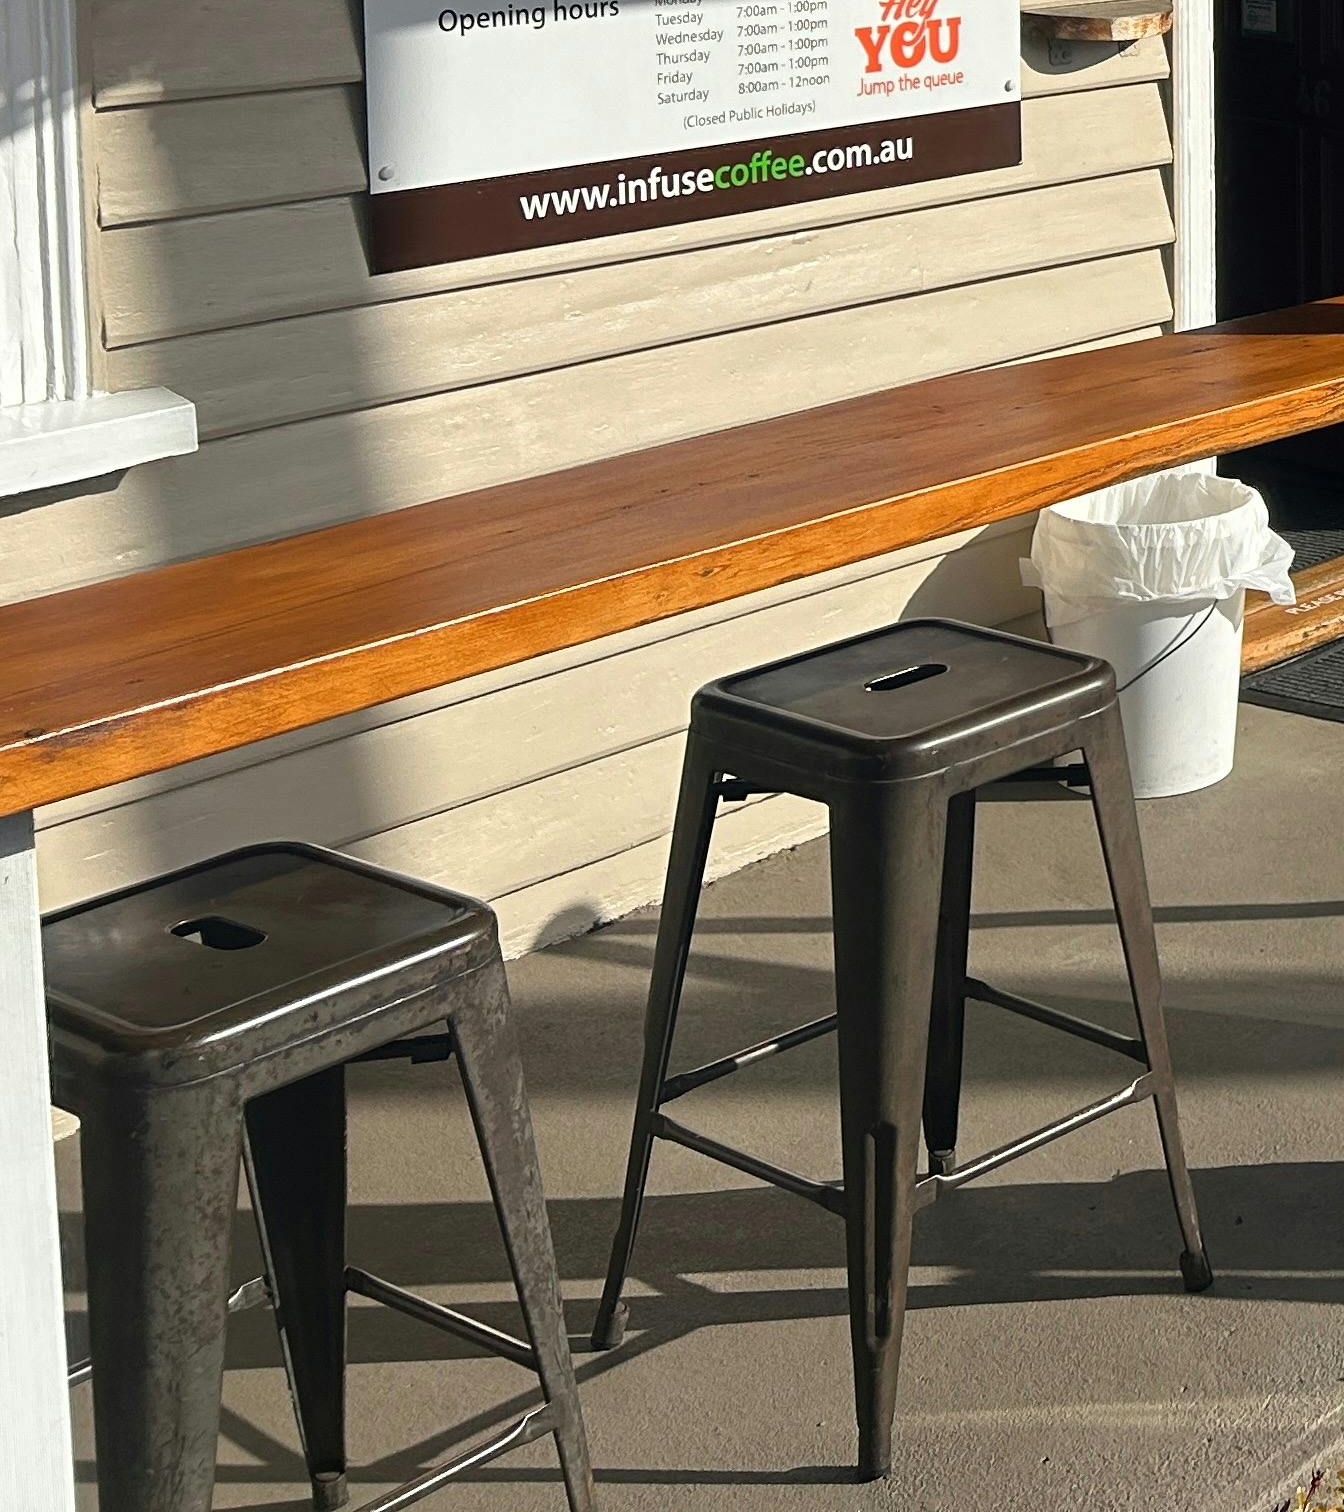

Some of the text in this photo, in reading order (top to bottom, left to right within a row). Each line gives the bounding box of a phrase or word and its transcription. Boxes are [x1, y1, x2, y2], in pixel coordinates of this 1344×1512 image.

[438, 0, 619, 36] Opening hours
[655, 11, 704, 26] Tuesday
[736, 5, 778, 18] 7:00am
[788, 0, 828, 14] 1:00pm
[656, 28, 724, 46] Wednesday
[737, 24, 778, 37] 7:00am
[789, 18, 828, 33] 1:00pm
[855, 16, 961, 74] YOU
[656, 49, 711, 65] Thursday
[737, 42, 778, 57] 7:00am
[789, 37, 828, 52] 1:00pm
[657, 70, 693, 85] Friday
[738, 61, 779, 76] 7:00am
[789, 56, 829, 70] 1:00pm
[857, 71, 964, 96] Jump the queue
[657, 87, 709, 105] Saturday
[738, 80, 779, 95] 8:00am
[789, 74, 830, 88] 12noon
[683, 100, 816, 129] (Closed Public Holidays)
[519, 135, 914, 220] www.infusecoffee.com.au
[1285, 593, 1342, 615] PLEASE
